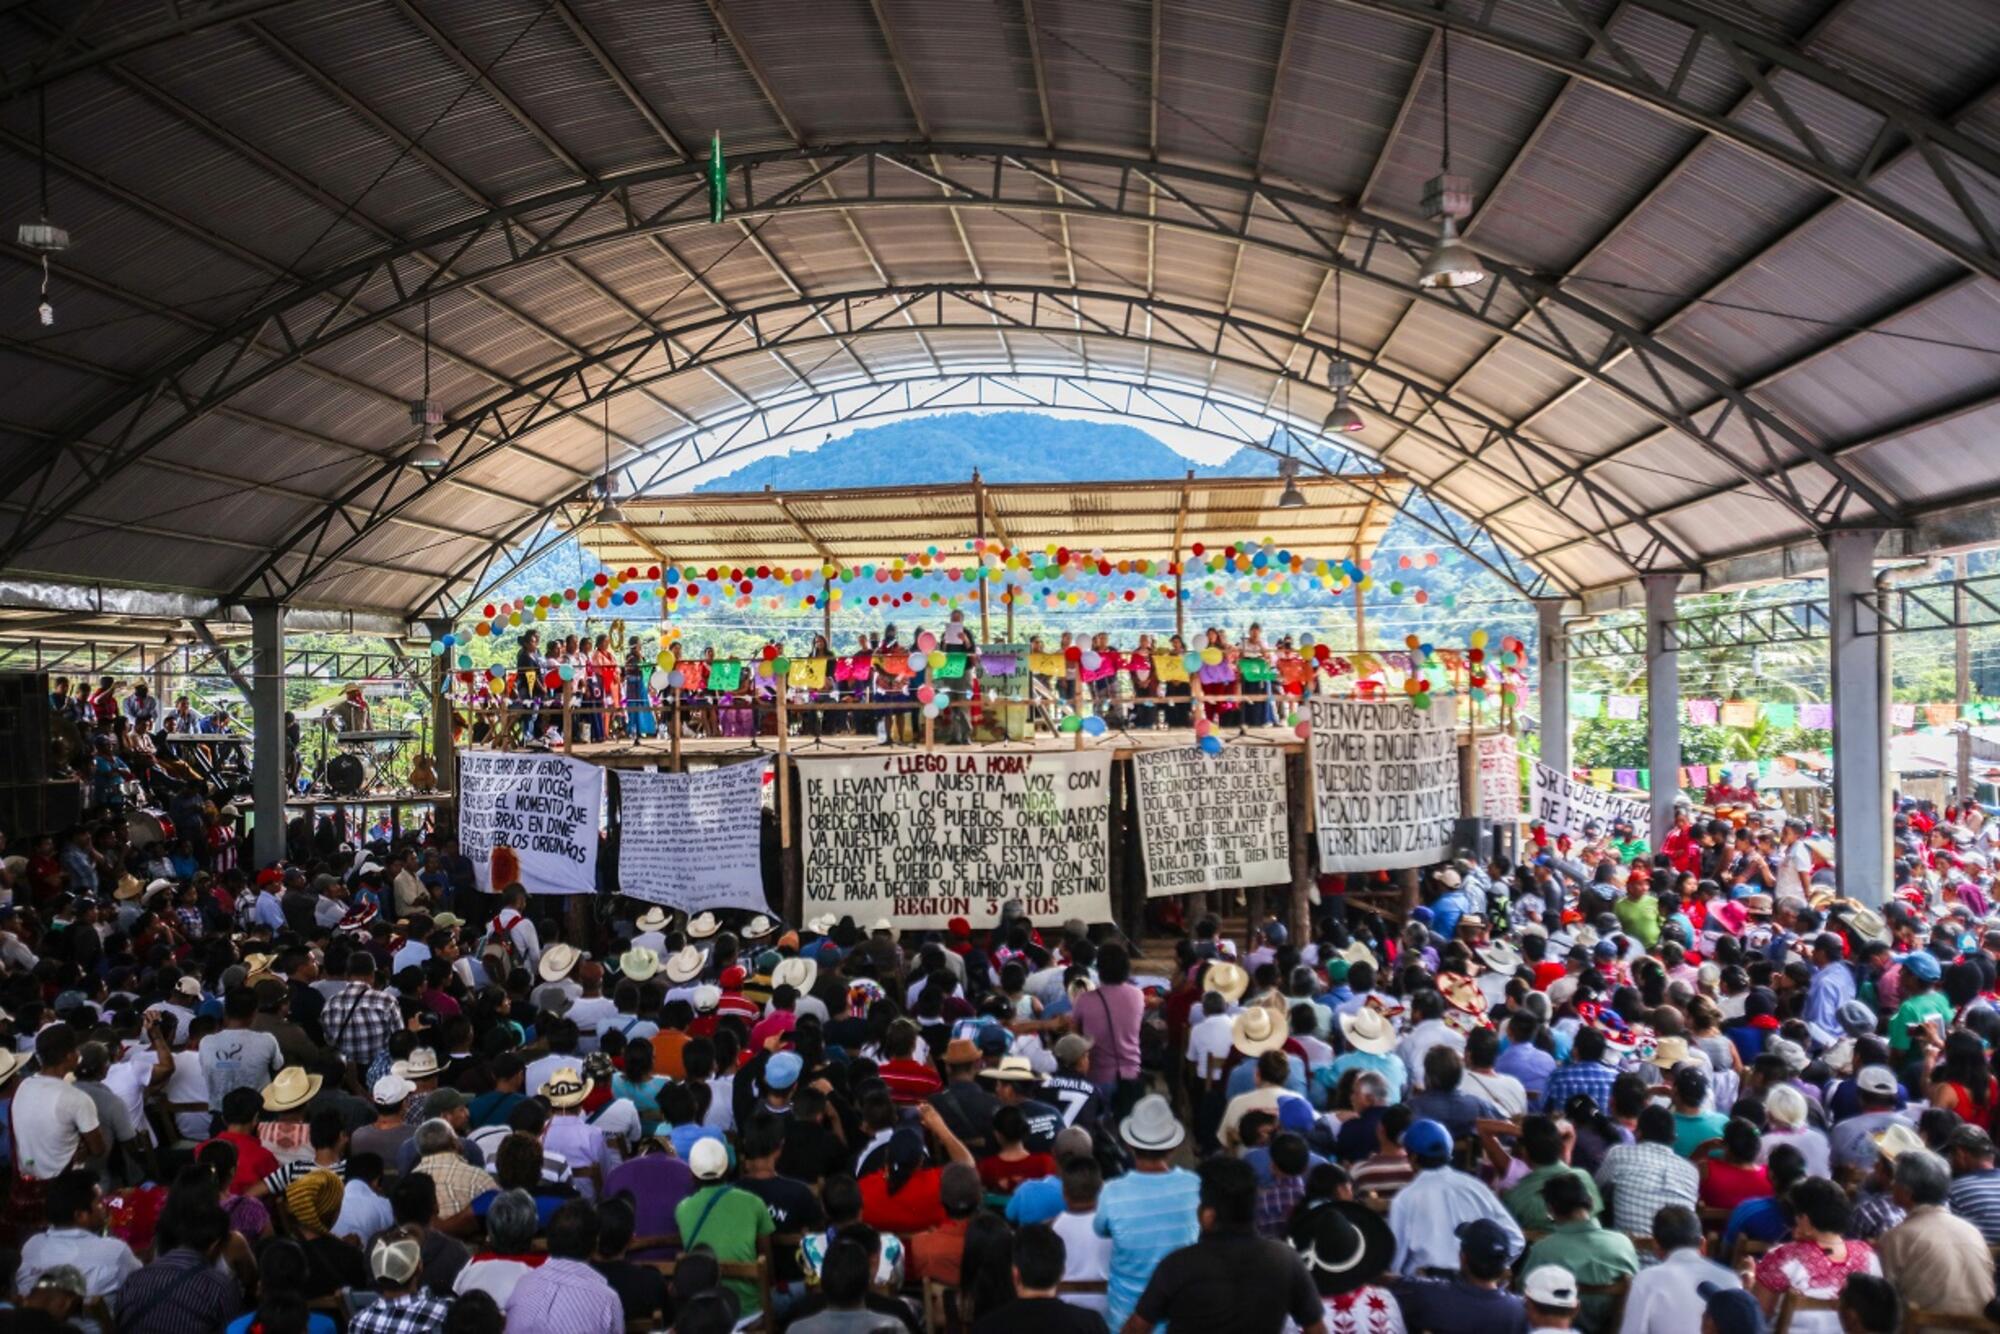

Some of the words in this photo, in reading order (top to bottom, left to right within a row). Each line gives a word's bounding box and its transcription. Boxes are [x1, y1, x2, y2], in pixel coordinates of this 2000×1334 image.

[1136, 747, 1204, 766] NOSOTROS
[1245, 747, 1260, 759] DE
[1314, 732, 1368, 762] PRIMER
[956, 756, 977, 774] LA
[987, 754, 1033, 775] HORA!
[1153, 760, 1208, 780] POLITICA
[807, 778, 824, 796] DE
[833, 774, 921, 796] LEVANTAR
[935, 773, 1007, 793] NUESTRA
[1023, 773, 1056, 793] VOZ
[1068, 769, 1102, 791] CON
[1142, 775, 1228, 796] RECONOCEMOS
[1231, 775, 1254, 790] QUE
[1257, 774, 1271, 788] ES
[1316, 763, 1372, 793] PUEBLOS
[1535, 763, 1560, 796] SR
[495, 793, 509, 810] EL
[515, 793, 564, 816] MOMENTO
[566, 804, 588, 825] QUE
[808, 794, 884, 813] MARICHUY
[894, 793, 911, 811] EL
[918, 789, 948, 809] CIG
[972, 792, 989, 810] EL
[1000, 791, 1058, 811] MANDAR
[1143, 794, 1184, 812] DOLOR
[1187, 793, 1194, 808] Y
[1318, 795, 1370, 824] MEXICO
[1540, 796, 1561, 826] DE
[528, 814, 544, 833] EN
[807, 810, 901, 832] OBEDECIENDO
[909, 807, 936, 828] LOS
[943, 808, 1004, 828] PUEBLOS
[1016, 804, 1108, 828] ORIGINARIOS
[1144, 811, 1168, 827] QUE
[1174, 807, 1192, 823] TE
[808, 830, 828, 849] VA
[834, 828, 901, 849] NUESTRA
[908, 826, 937, 846] VOZ
[960, 826, 1031, 847] NUESTRA
[1039, 823, 1101, 845] PALABRA
[1145, 824, 1179, 842] PASO
[1320, 825, 1401, 857] TERRITORIO
[806, 847, 884, 867] ADELANTE
[1001, 844, 1070, 864] ESTAMOS
[1078, 840, 1106, 860] CON
[1147, 836, 1208, 857] ESTAMOS
[1224, 850, 1241, 865] EL
[1244, 848, 1269, 864] BIEN
[1273, 845, 1289, 860] DE
[806, 864, 867, 884] USTEDES
[874, 864, 891, 882] EL
[895, 861, 944, 881] PUEBLO
[952, 862, 969, 881] SE
[976, 862, 1045, 881] LEVANTA
[1052, 860, 1083, 880] CON
[1090, 858, 1107, 876] SU
[1152, 868, 1206, 888] NUESTRO
[1211, 865, 1242, 881] ATRIA
[806, 883, 837, 901] VOZ
[843, 882, 879, 901] PARA
[884, 880, 930, 899] DECIDIR
[938, 879, 957, 898] SU
[962, 879, 1009, 898] RUMBO
[1025, 880, 1044, 898] SU
[1052, 875, 1107, 897] DESTINO
[892, 897, 970, 916] REGION
[985, 898, 999, 916] 3
[1016, 897, 1060, 917] IOS
[1058, 1088, 1090, 1130] 7
